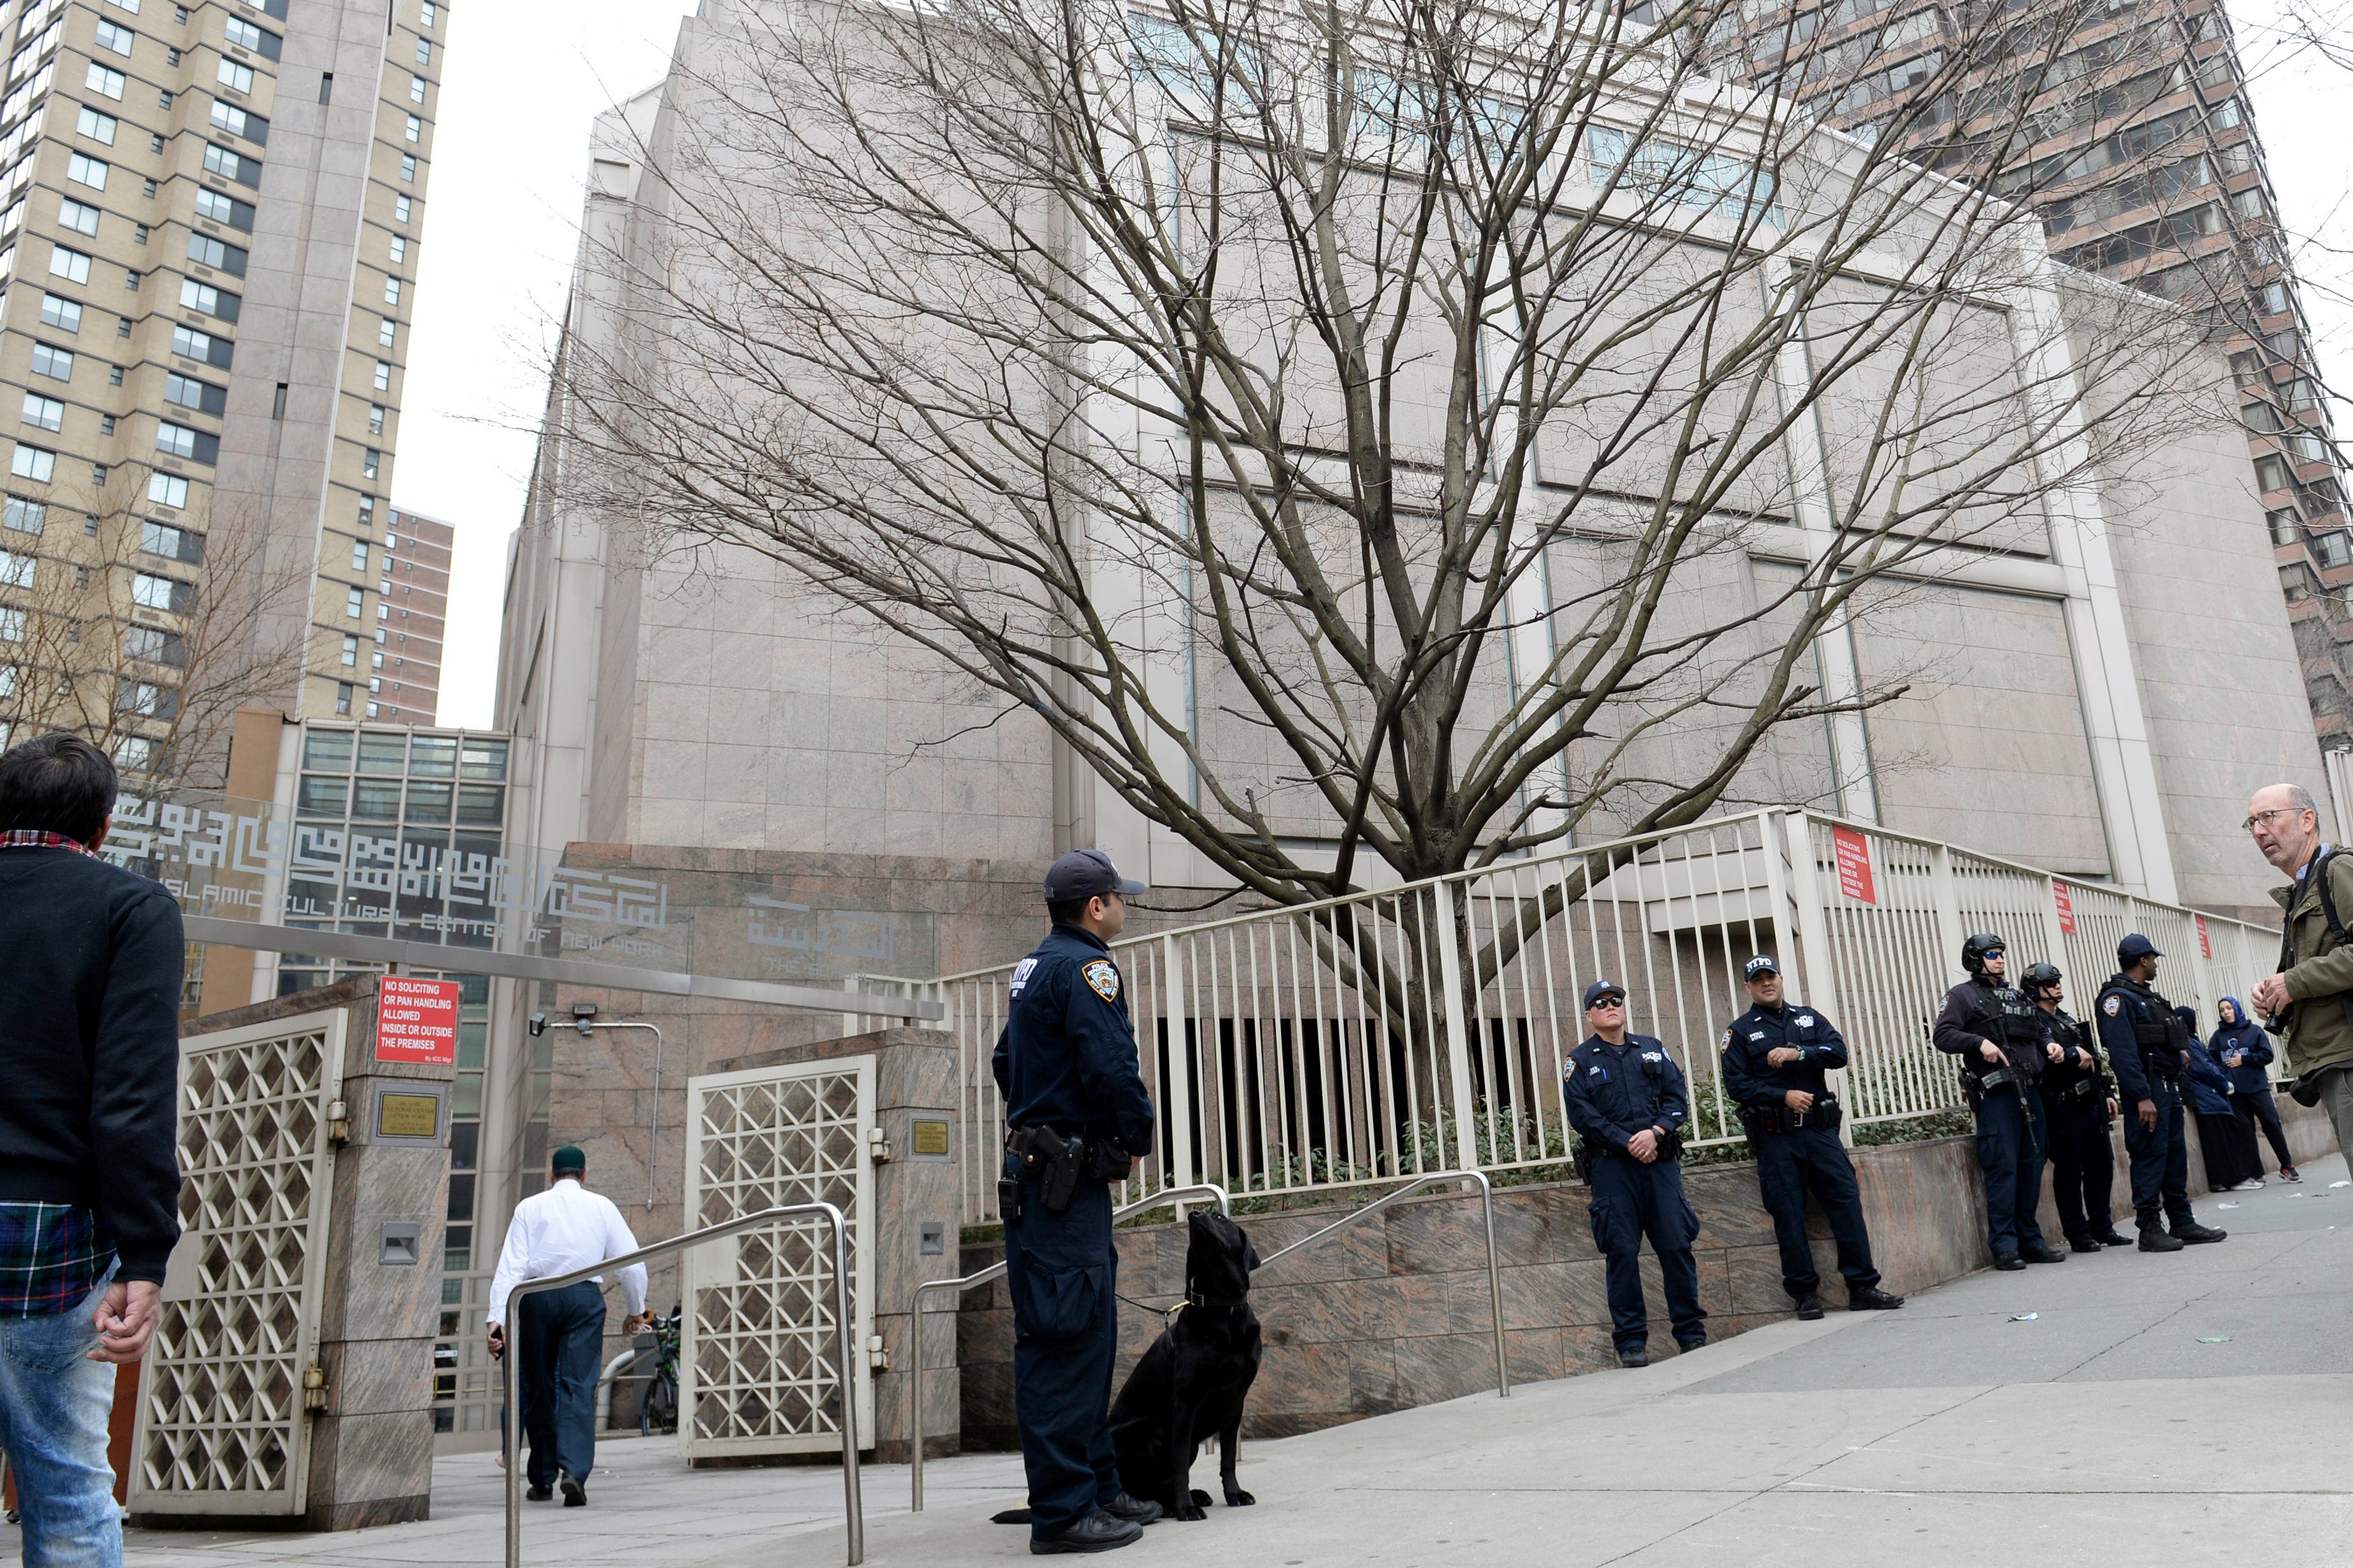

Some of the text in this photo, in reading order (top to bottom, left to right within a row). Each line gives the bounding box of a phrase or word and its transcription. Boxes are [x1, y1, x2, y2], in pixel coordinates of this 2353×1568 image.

[276, 894, 409, 927] CULTURAL
[421, 913, 513, 939] CENTER
[523, 925, 551, 942] OF
[561, 932, 603, 951] NEW
[612, 938, 662, 957] YORK
[766, 957, 801, 974] THE
[1012, 958, 1038, 981] NYPD
[1746, 957, 1772, 973] NYPD
[385, 981, 440, 995] NO SOLICITING
[384, 995, 452, 1010] OR PAN HANDLING
[383, 1009, 420, 1021] ALLOWED
[382, 1023, 452, 1038] INSIDE OR OUTSIDE
[381, 1037, 435, 1050] THE PREMISES
